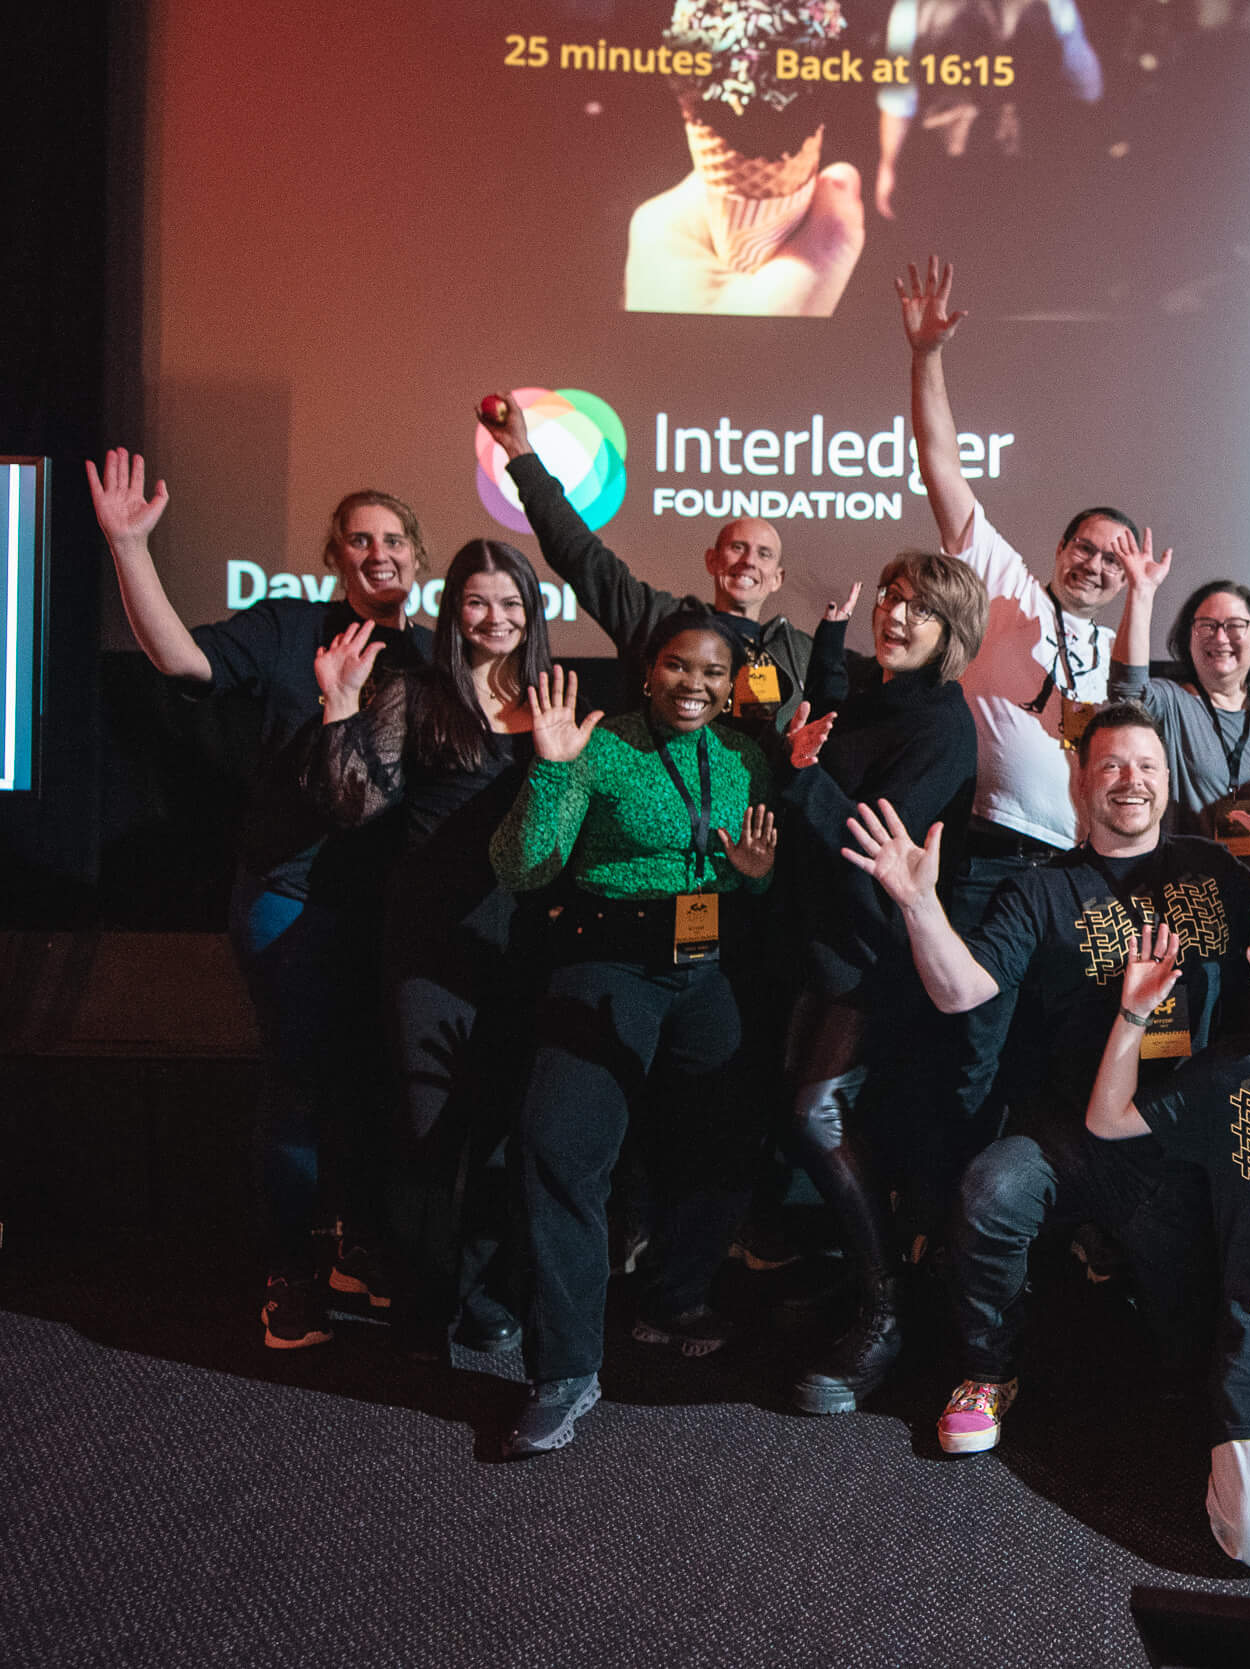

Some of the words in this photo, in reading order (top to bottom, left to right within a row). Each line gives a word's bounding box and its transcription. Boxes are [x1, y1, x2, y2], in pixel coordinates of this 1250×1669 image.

[503, 35, 549, 67] 25
[560, 41, 713, 76] minutes
[776, 49, 863, 82] Back
[872, 56, 909, 83] at
[921, 54, 1016, 87] 16:15
[655, 411, 1015, 496] Interleder
[653, 488, 902, 520] FOUNDATION
